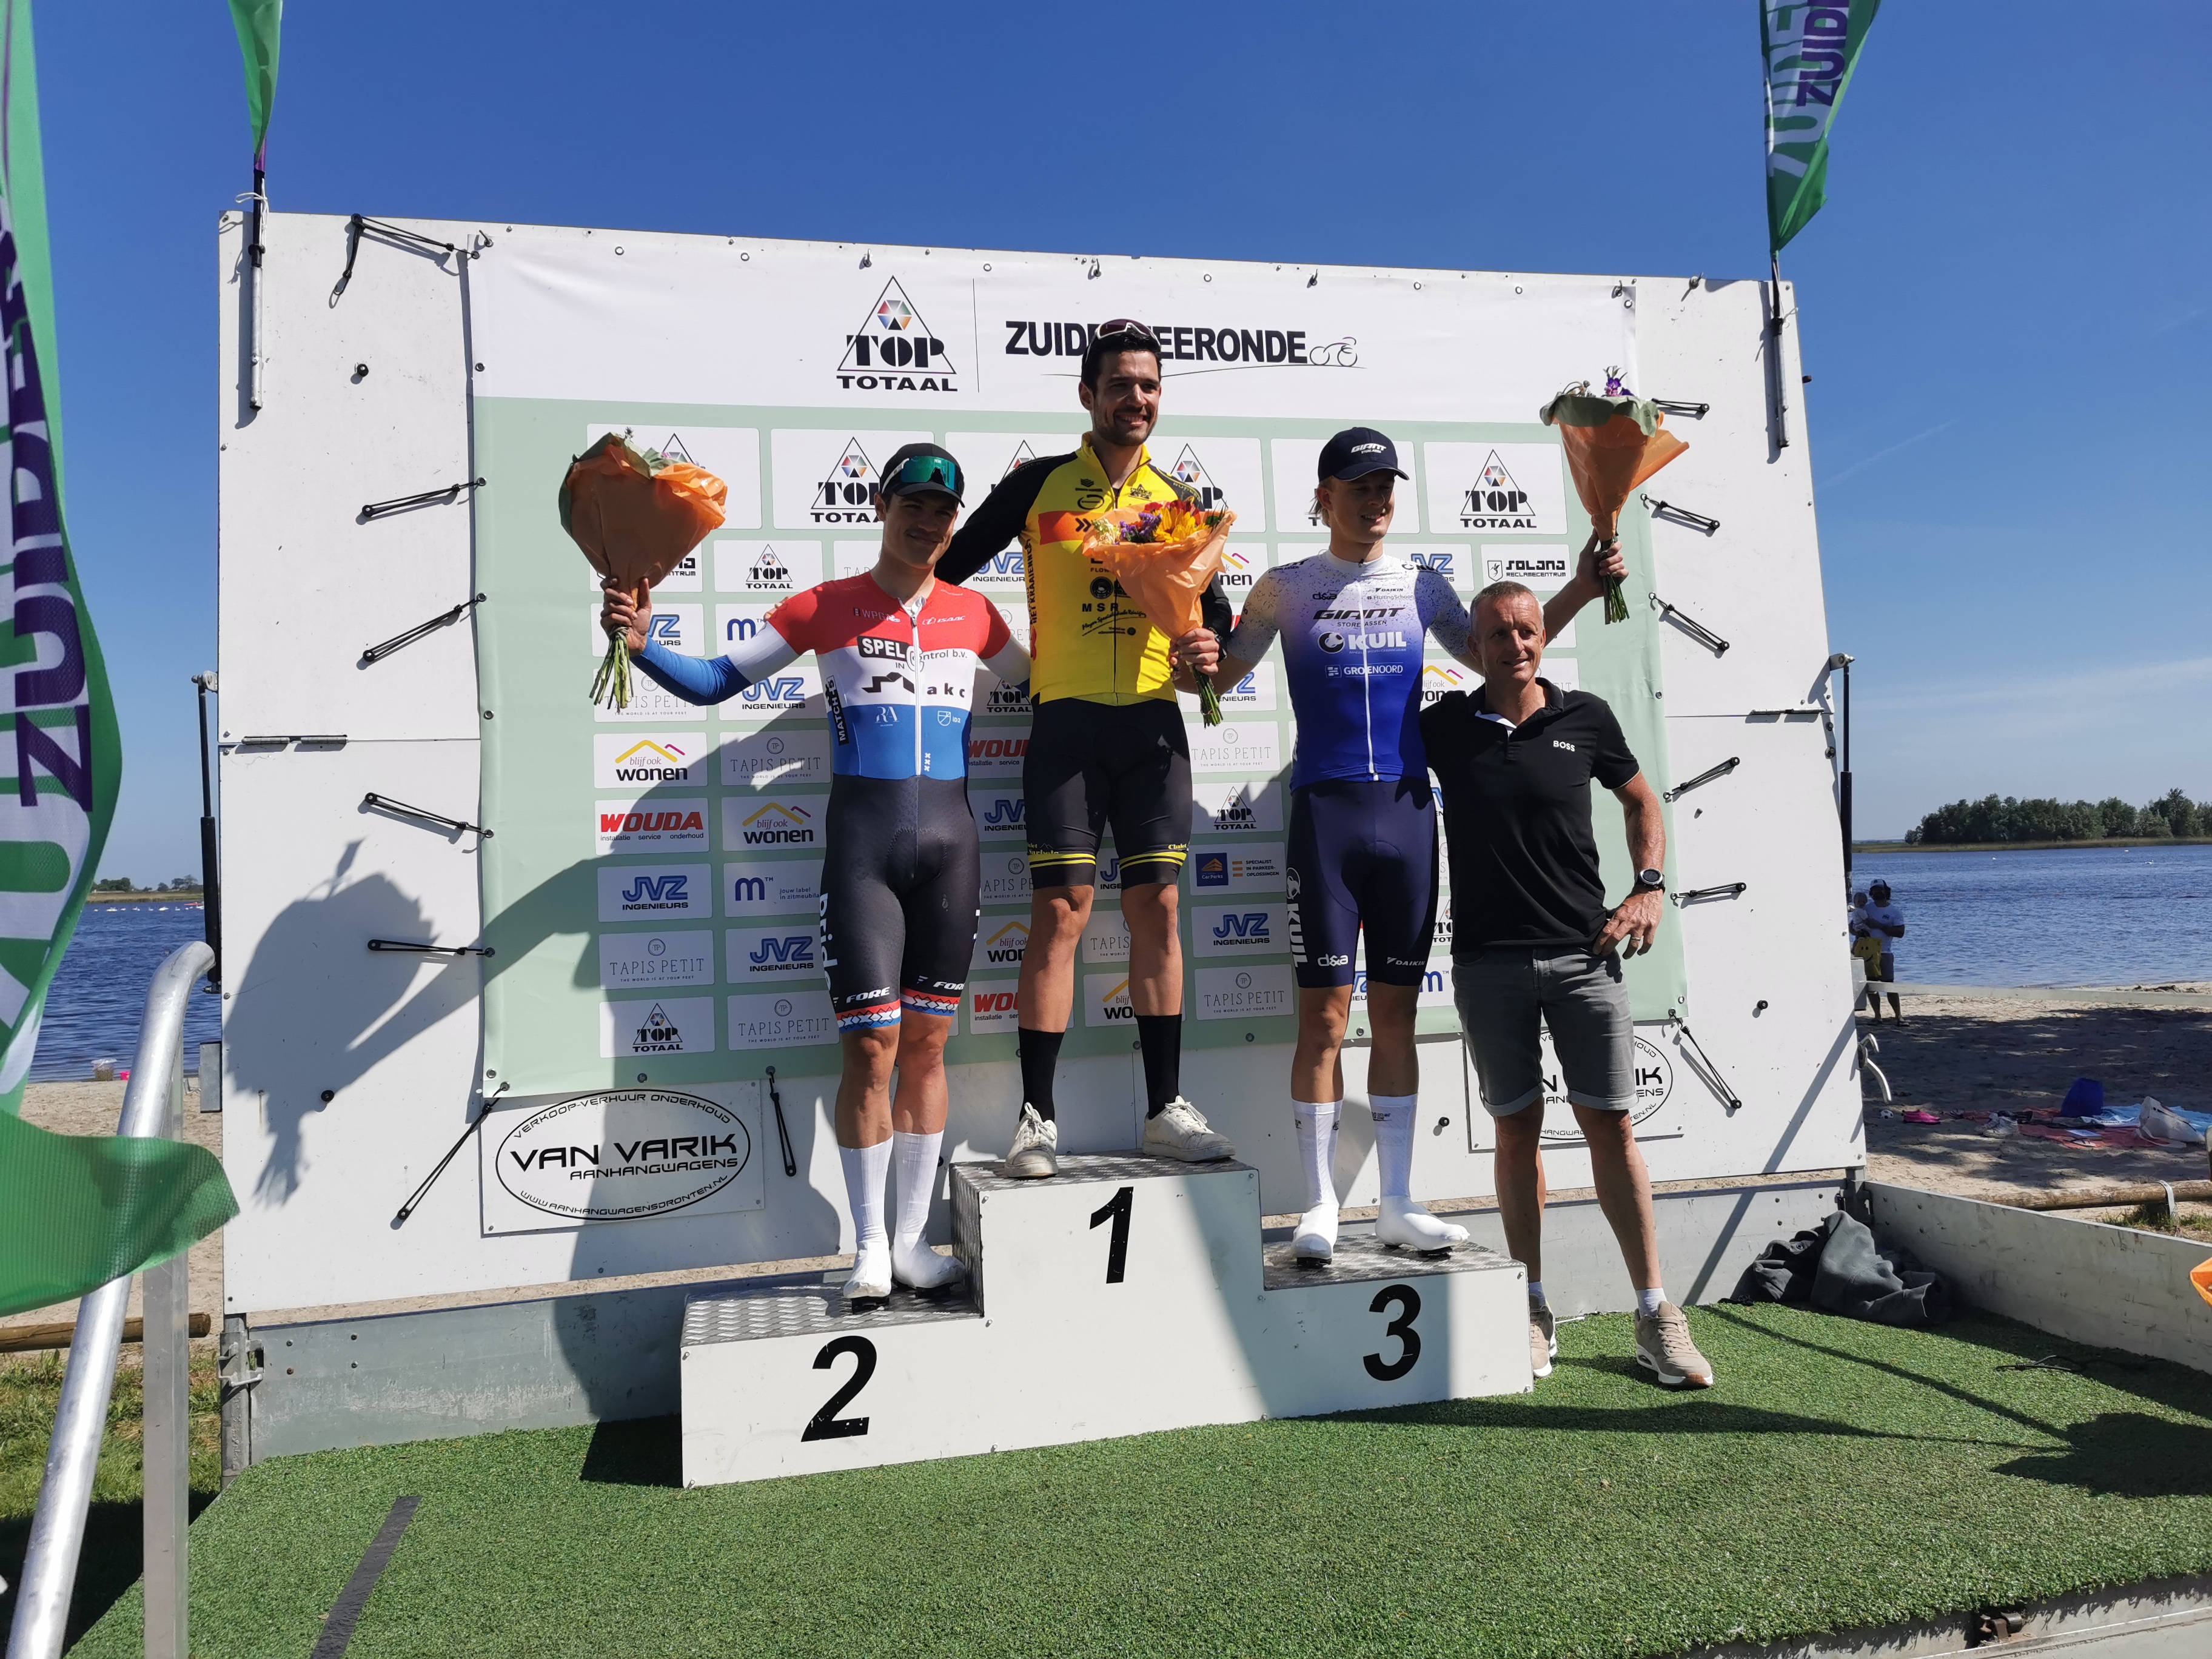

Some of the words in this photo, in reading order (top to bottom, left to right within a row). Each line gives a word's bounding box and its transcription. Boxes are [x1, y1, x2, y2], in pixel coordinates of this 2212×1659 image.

[1005, 321, 1308, 364] ZUIDEERONDE
[847, 335, 945, 367] TOP
[836, 375, 957, 392] TOTAAL
[1351, 443, 1386, 453] GIANT
[1466, 491, 1527, 512] TOP
[810, 512, 882, 523] TOTA
[1460, 518, 1537, 528] TOTAAL
[1506, 560, 1566, 571] SOLANA
[749, 568, 788, 580] TOP
[1221, 574, 1252, 586] nen
[1312, 591, 1338, 600] d&a
[1313, 608, 1406, 620] GIANT
[1348, 632, 1407, 650] KUIL
[862, 638, 905, 659] SPEL
[953, 649, 968, 659] b.v.
[1424, 680, 1432, 689] lijf
[1553, 740, 1575, 752] BOSS
[1191, 748, 1229, 760] TAPIS
[1235, 747, 1271, 759] PETIT
[629, 757, 646, 767] blijf
[730, 758, 774, 772] TAPIS
[780, 757, 820, 771] PETIT
[616, 768, 688, 781] wonen
[1217, 808, 1252, 821] TOP
[600, 811, 703, 832] WOUDA
[757, 819, 773, 830] blijf
[743, 829, 814, 844] wonen
[622, 875, 688, 902] JVZ
[736, 877, 765, 901] m
[984, 879, 1014, 891] APIS
[622, 902, 688, 911] INGENIEURS
[1213, 913, 1270, 939] JVZ
[1287, 903, 1308, 967] KUIL
[749, 936, 814, 964] JVZ
[1000, 939, 1014, 948] blijf
[1091, 937, 1130, 950] TAPIS
[610, 960, 655, 975] TAPIS
[662, 958, 704, 973] PETIT
[1318, 954, 1349, 967] d&a
[749, 963, 814, 972] INGENIEURS
[933, 982, 965, 990] FOR
[846, 986, 891, 1004] FORE
[1116, 996, 1130, 1005] blijf
[1204, 993, 1242, 1007] TAPIS
[1248, 991, 1284, 1004] PETIT
[739, 1021, 781, 1036] TAPIS
[788, 1018, 829, 1033] PETIT
[637, 1028, 678, 1042] TOP
[632, 1044, 683, 1053] TOTAAL
[514, 1094, 646, 1138] VERKOOP-VERHUUR
[651, 1094, 731, 1124] ONDERHOUD
[510, 1144, 599, 1172] VAN
[614, 1133, 737, 1164] VARIK
[570, 1158, 738, 1181] AANHANGWAGENS
[1090, 1186, 1134, 1284] 1
[1362, 1284, 1422, 1382] 3
[801, 1335, 877, 1442] 2
